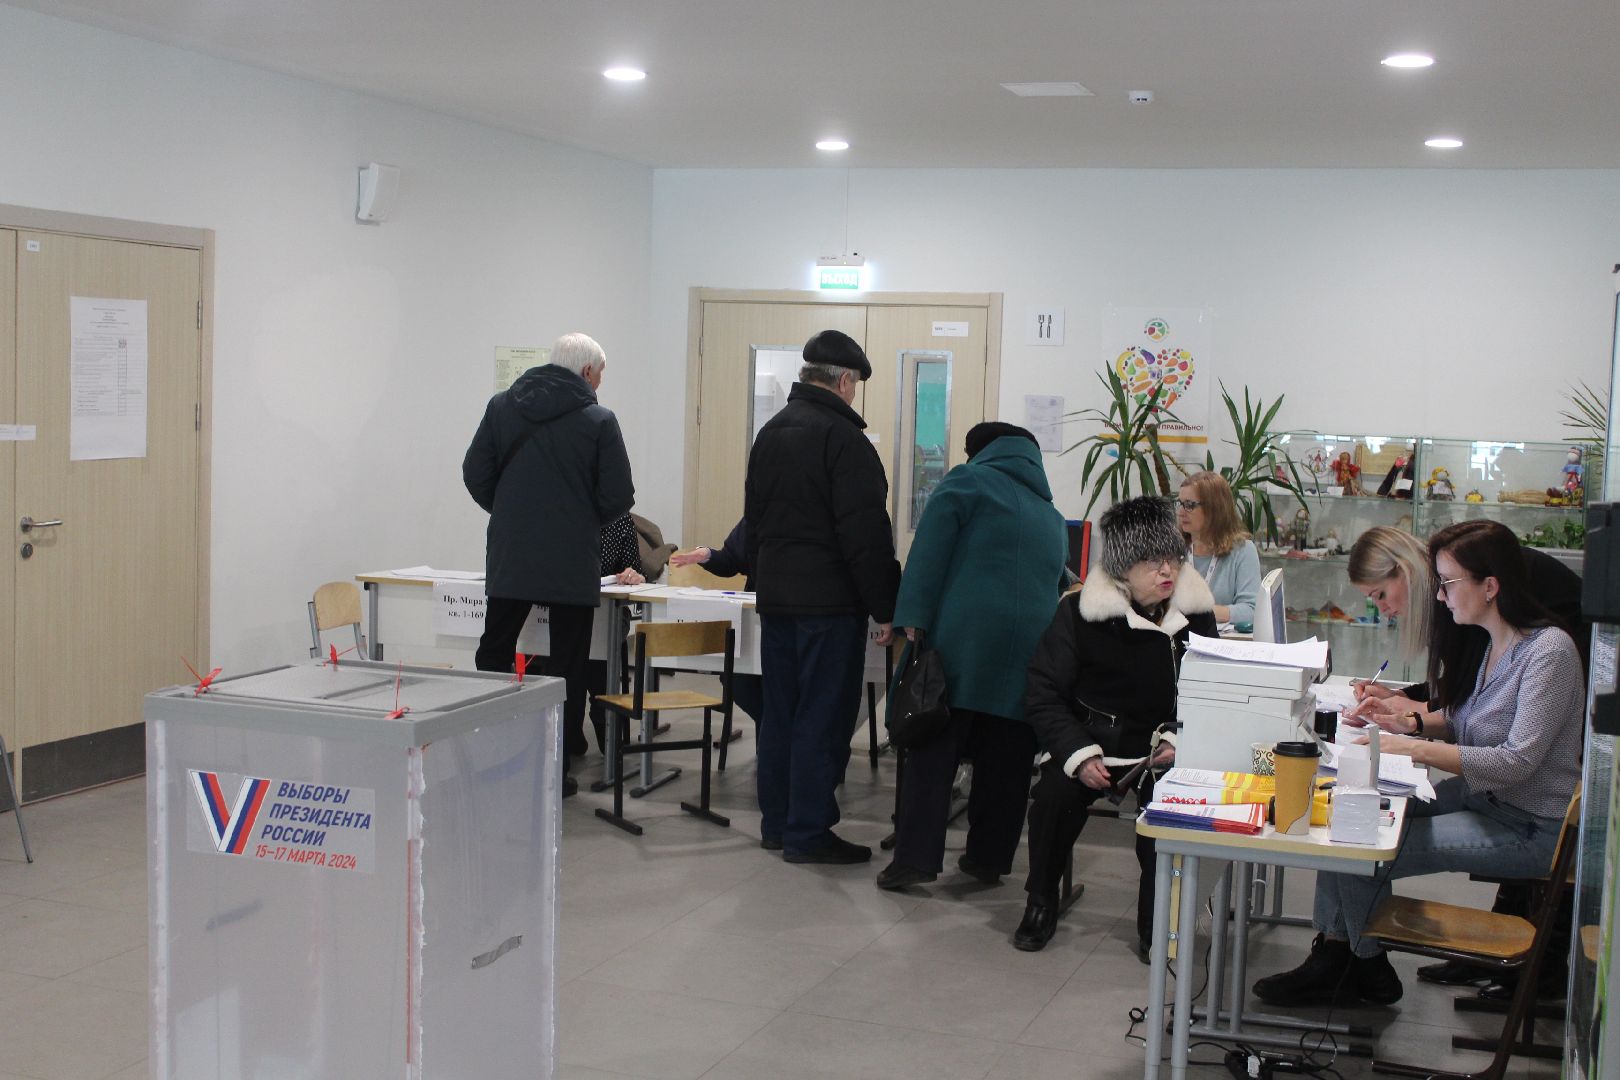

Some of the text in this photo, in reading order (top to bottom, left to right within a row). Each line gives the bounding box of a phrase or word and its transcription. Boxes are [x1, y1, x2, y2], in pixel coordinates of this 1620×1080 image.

[443, 595, 458, 605] Пр.
[460, 596, 483, 606] Мира
[277, 782, 351, 804] ВЫБОРЫ
[269, 803, 372, 830] ПРЕЗИДЕНТА
[261, 824, 327, 847] РОССИИ
[287, 849, 326, 866] МАРТА
[328, 854, 357, 870] 2024
